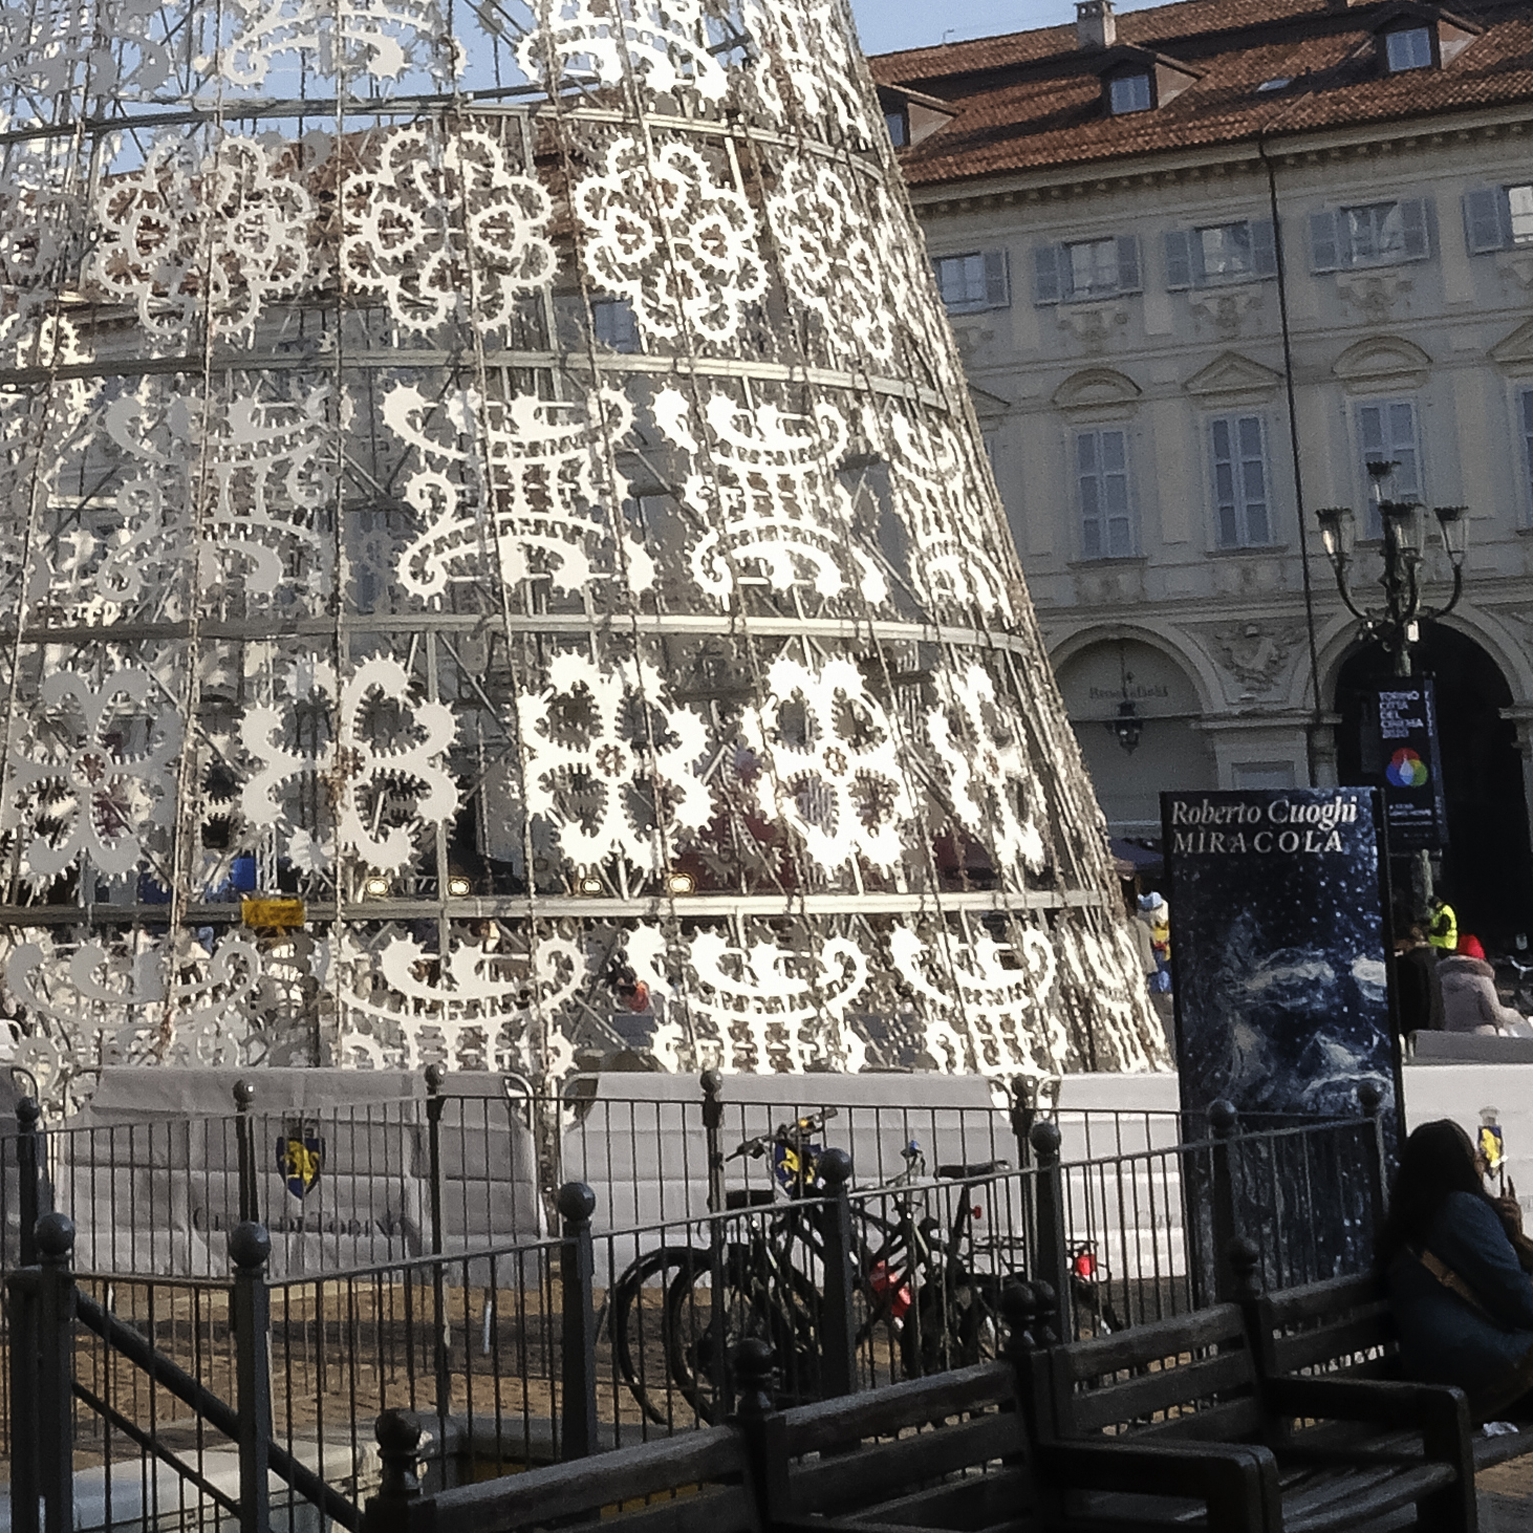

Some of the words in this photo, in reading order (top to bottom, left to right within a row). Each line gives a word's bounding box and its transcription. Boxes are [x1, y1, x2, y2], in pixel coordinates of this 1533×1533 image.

[1169, 799, 1262, 825] Roberto
[1267, 793, 1358, 832] Cuoghi
[1170, 830, 1344, 854] MIRACOLA
